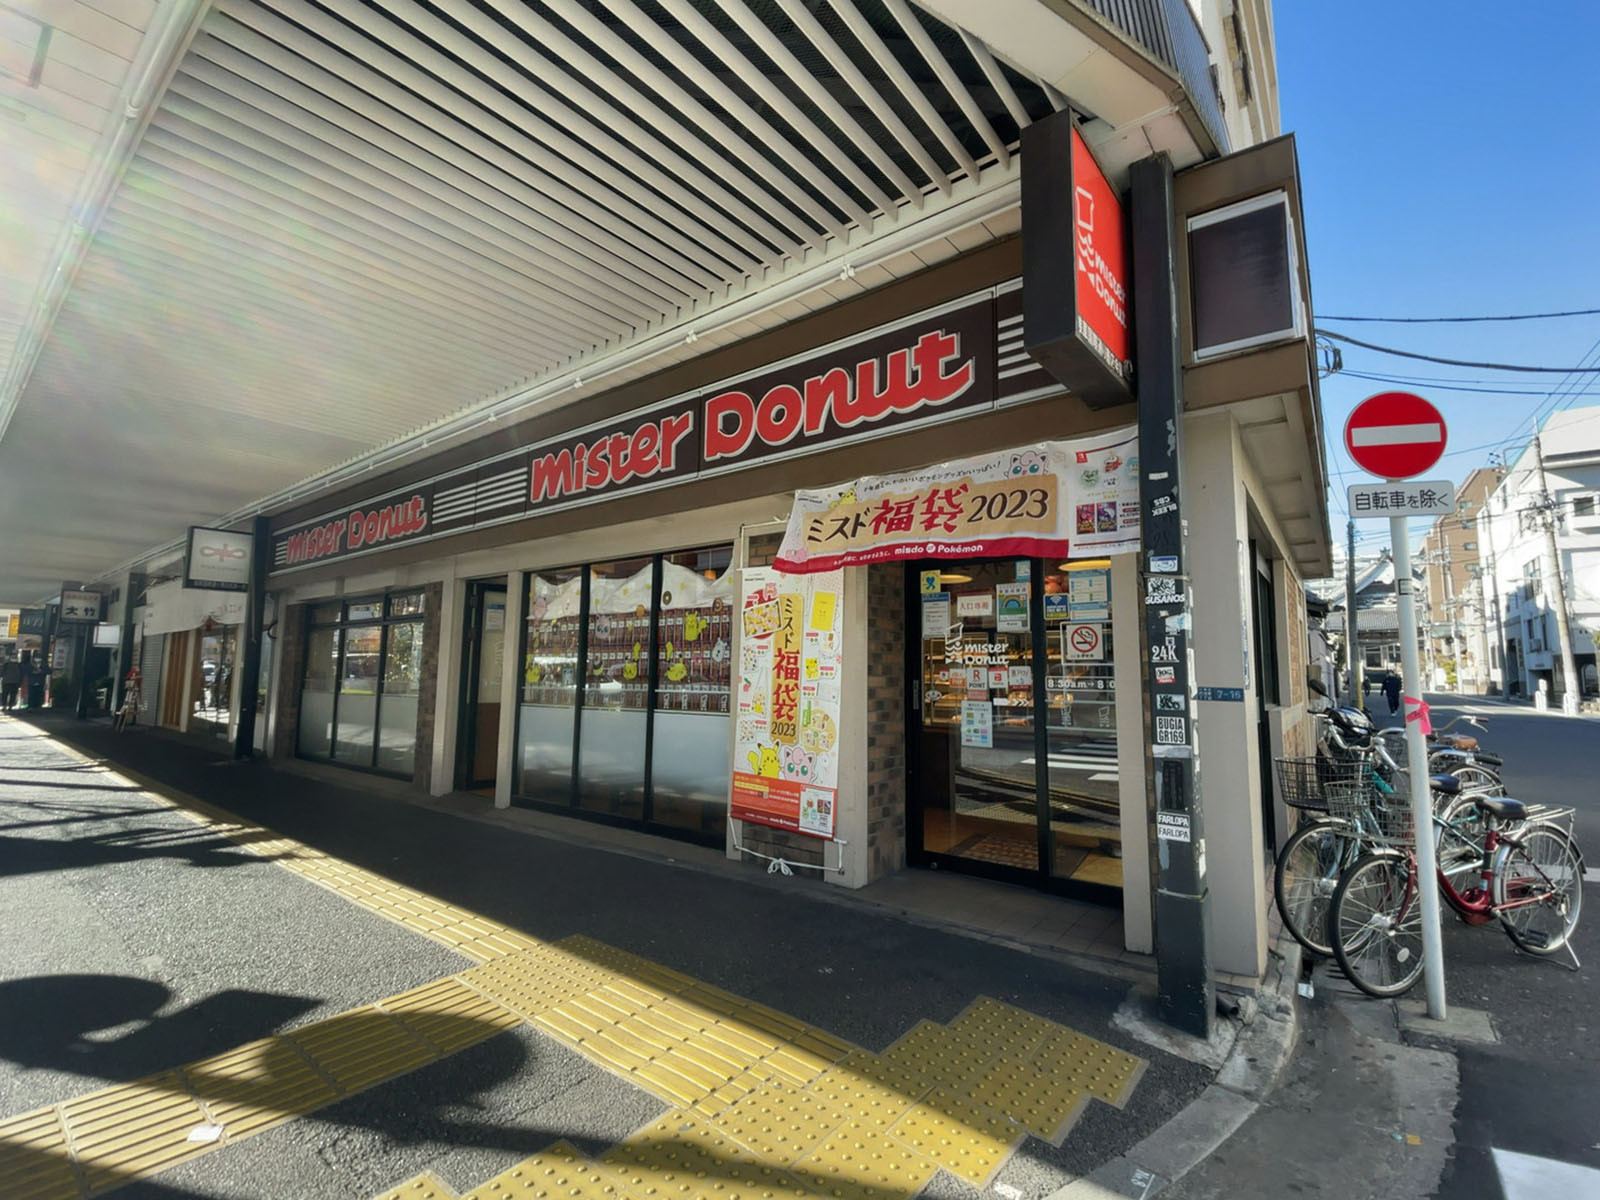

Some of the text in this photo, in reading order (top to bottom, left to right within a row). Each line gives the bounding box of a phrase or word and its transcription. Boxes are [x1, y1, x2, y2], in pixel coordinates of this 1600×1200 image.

[703, 328, 976, 461] Donut
[1355, 489, 1449, 511] 自転車を除く
[347, 495, 427, 549] Donut
[894, 543, 984, 555] misdo Pokémon
[1144, 593, 1186, 605] GUSANOS
[1151, 645, 1178, 661] 24K
[771, 721, 797, 737] 2023
[1158, 717, 1183, 731] BUGIA
[1158, 730, 1184, 743] GR169
[1158, 814, 1189, 827] FARLOPA
[1158, 826, 1189, 839] FARLOPA
